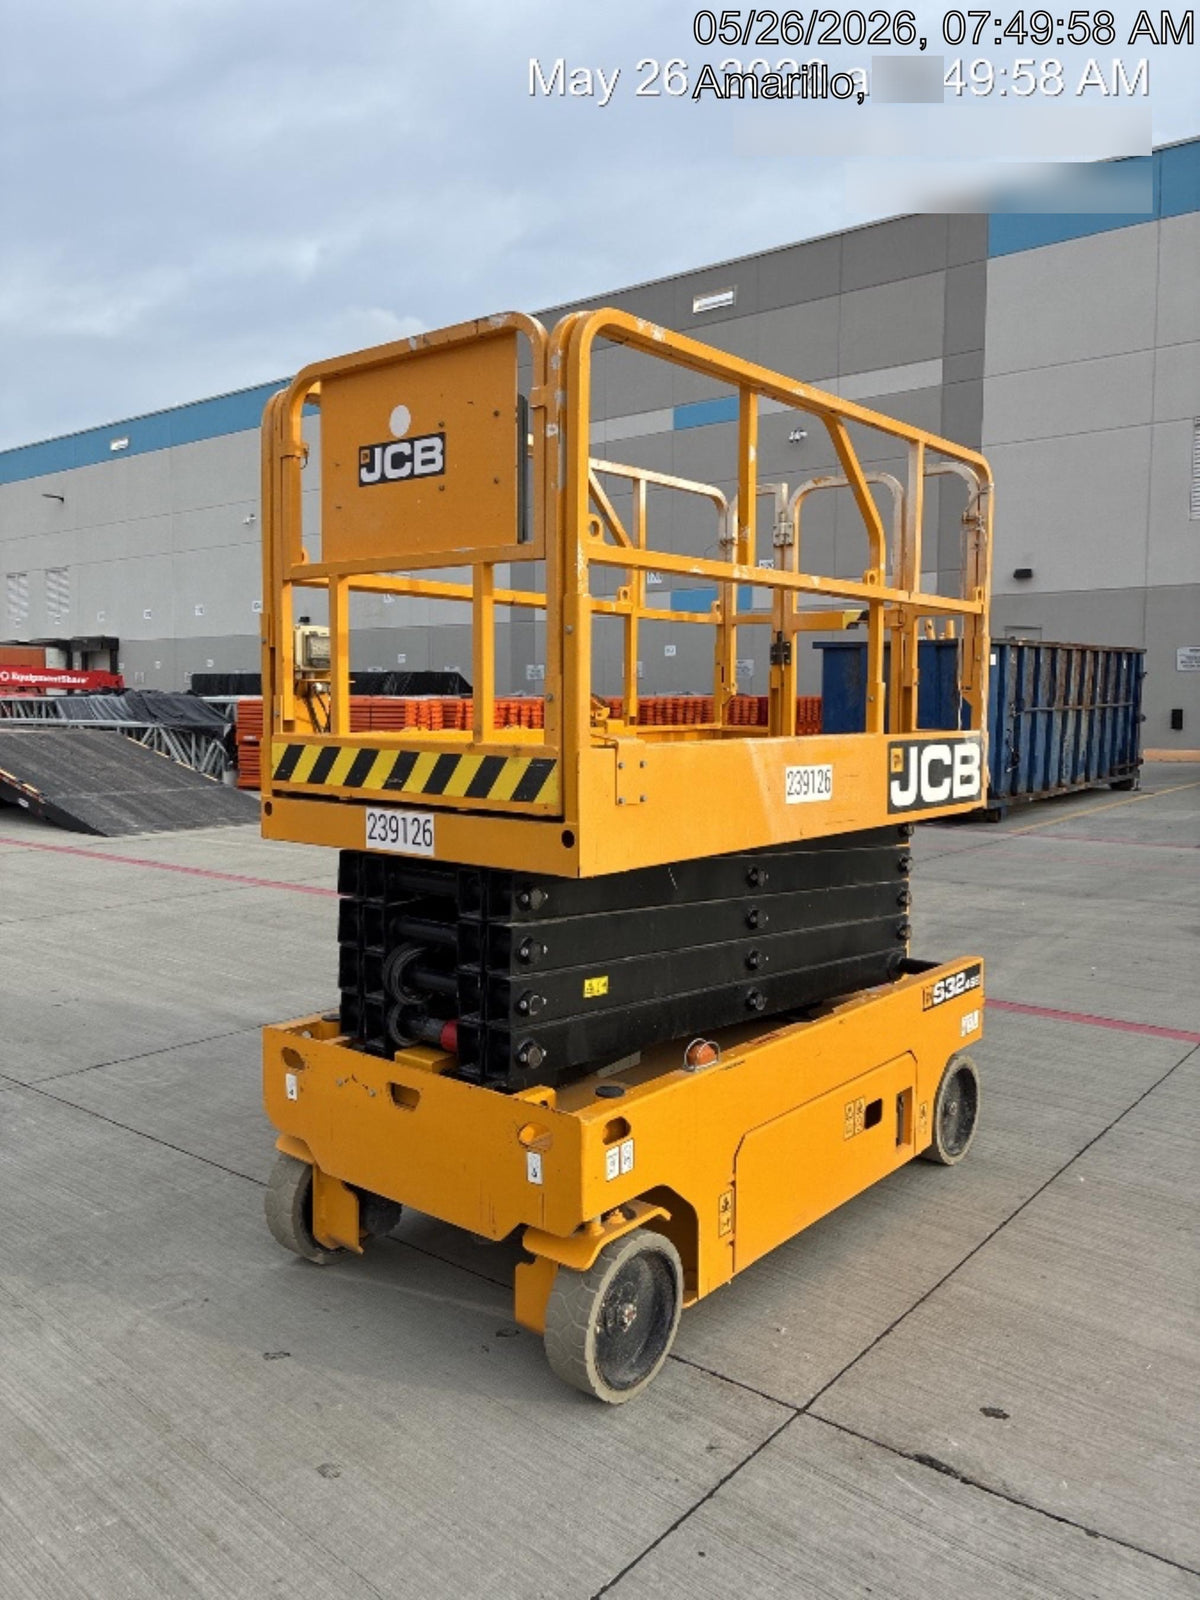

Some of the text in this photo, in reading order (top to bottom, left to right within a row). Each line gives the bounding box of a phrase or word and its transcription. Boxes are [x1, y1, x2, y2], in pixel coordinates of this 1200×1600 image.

[360, 436, 443, 482] JCB
[787, 769, 831, 796] 239126
[890, 742, 981, 807] JCB
[367, 812, 433, 847] 239126
